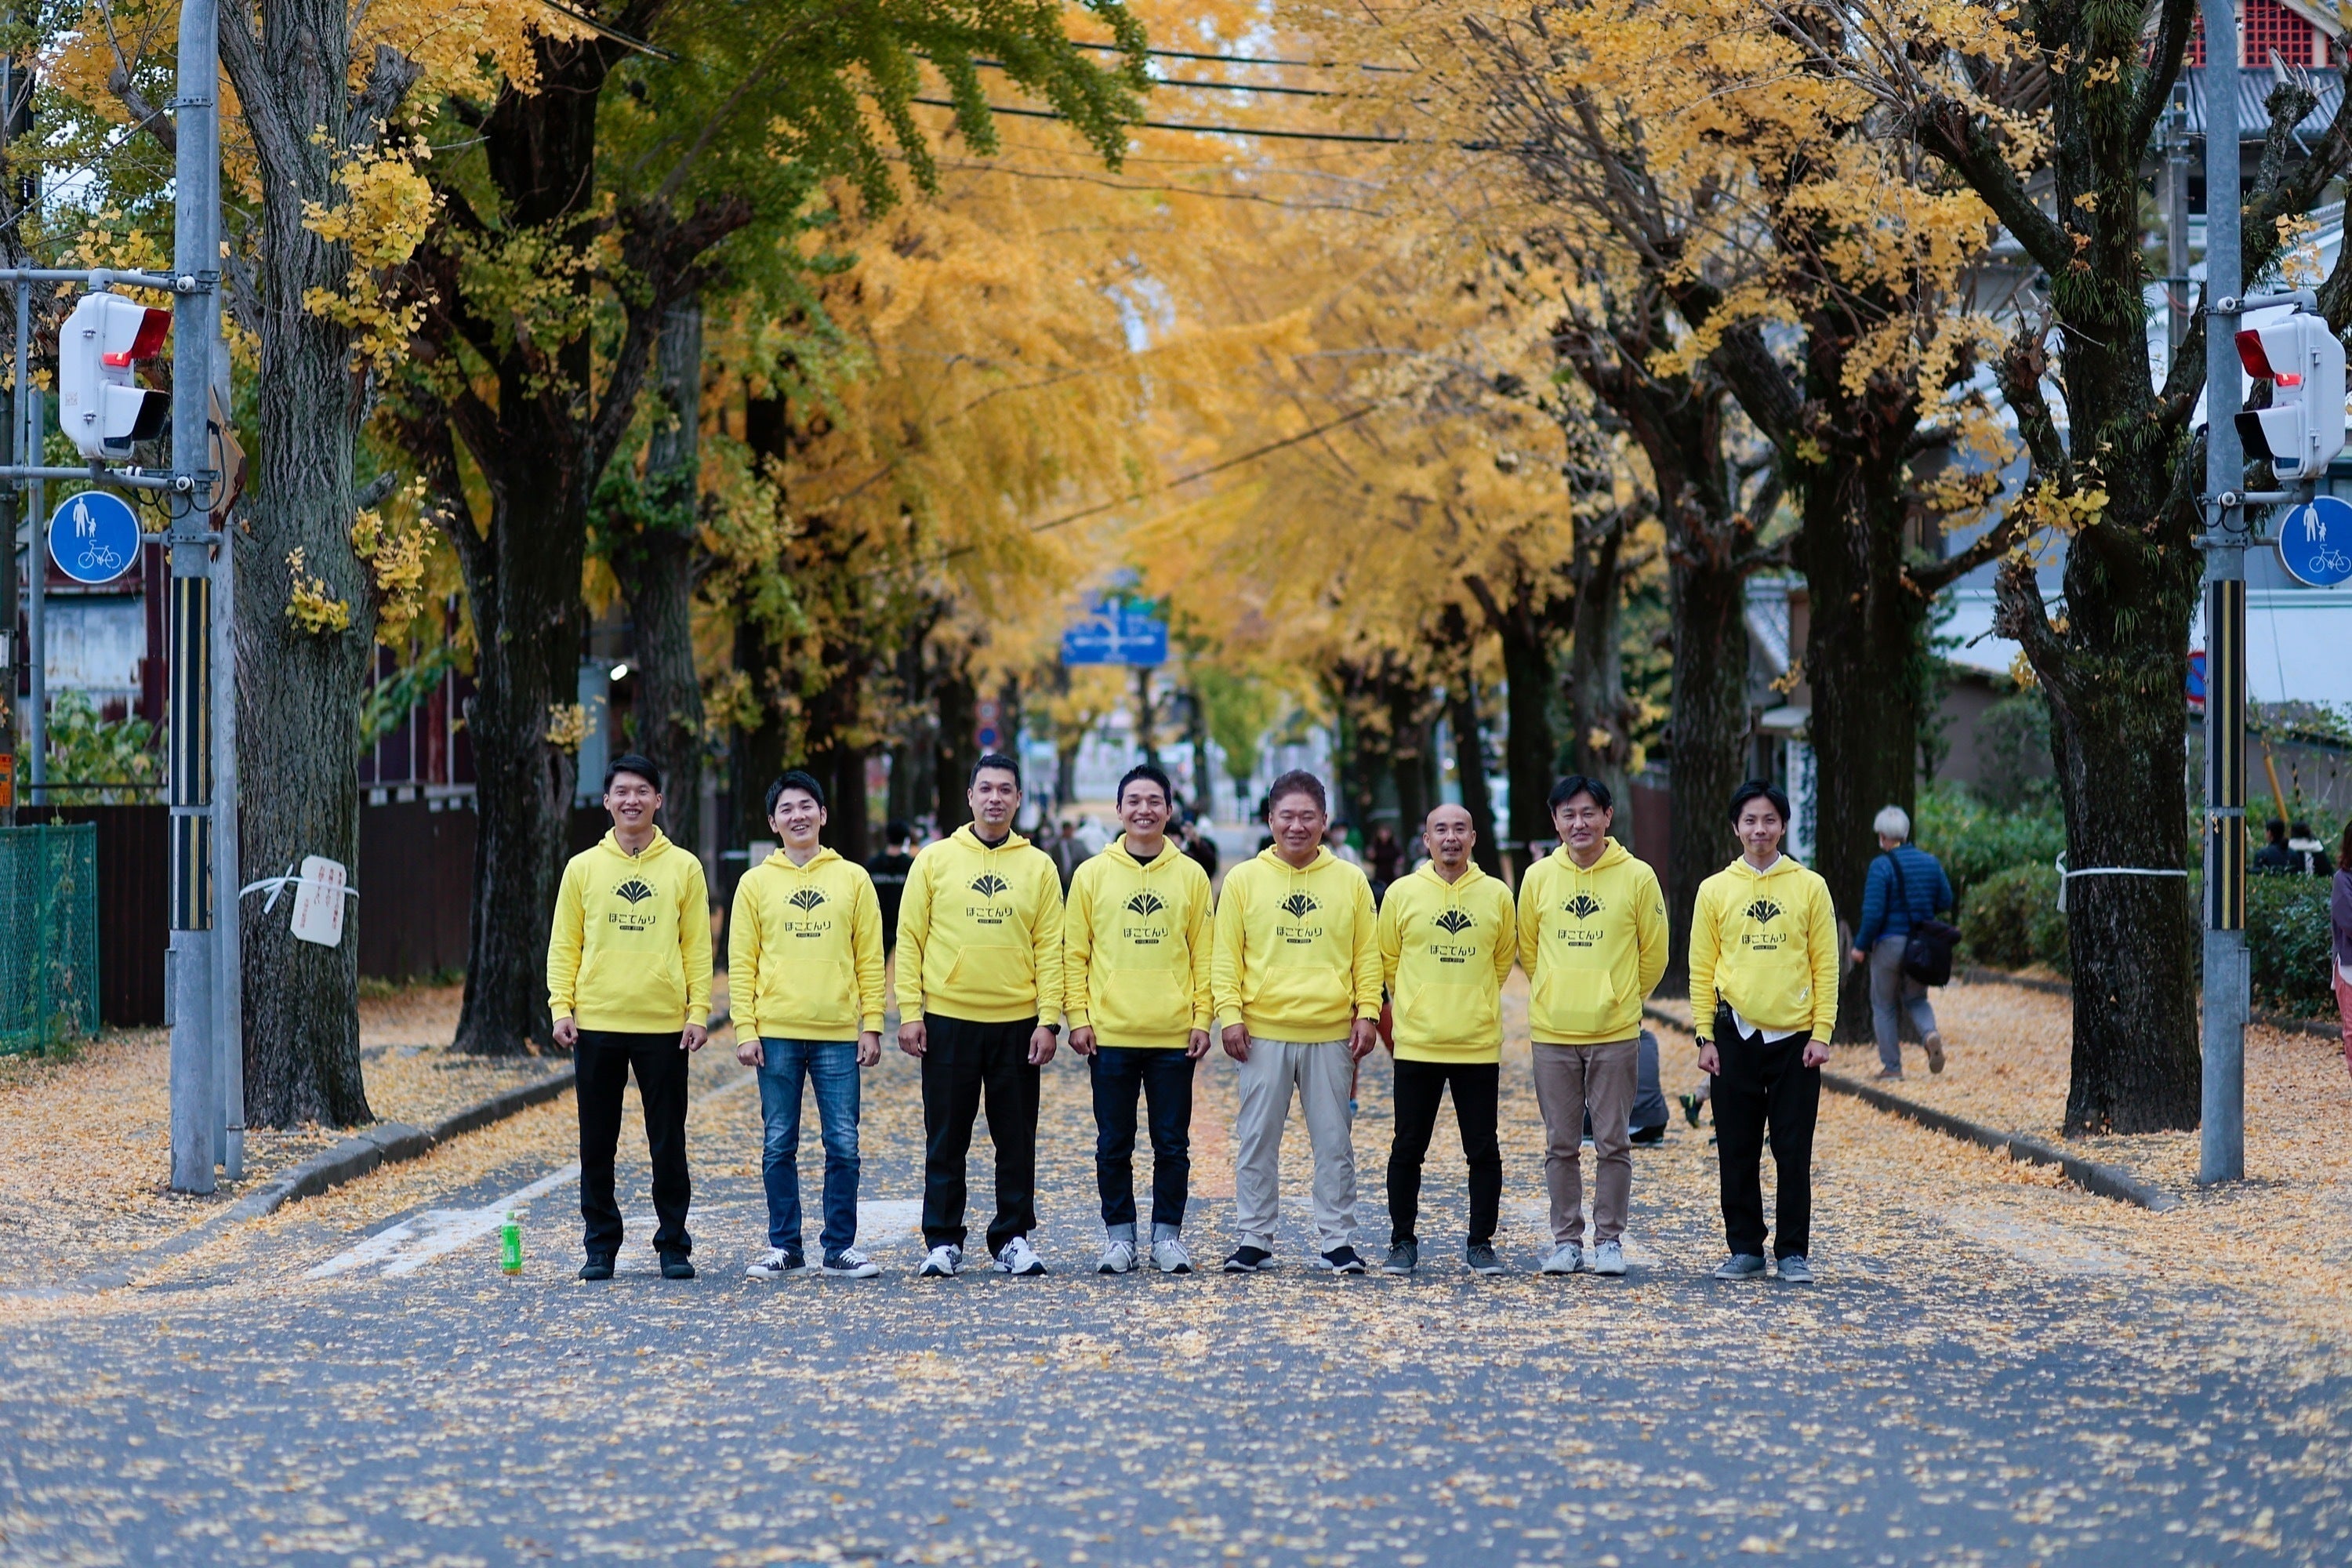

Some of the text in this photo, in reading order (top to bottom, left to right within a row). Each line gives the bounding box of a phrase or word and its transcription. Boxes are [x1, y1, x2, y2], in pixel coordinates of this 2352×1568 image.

[967, 907, 1012, 917] ほこてんり
[610, 913, 655, 924] ほこてんり
[1123, 927, 1168, 938] ほこてんり
[1277, 927, 1322, 937] ほこてんり
[1559, 930, 1602, 940] ほこてんり
[1742, 932, 1786, 944] ほこてんり
[1431, 945, 1475, 956] ほこてんり
